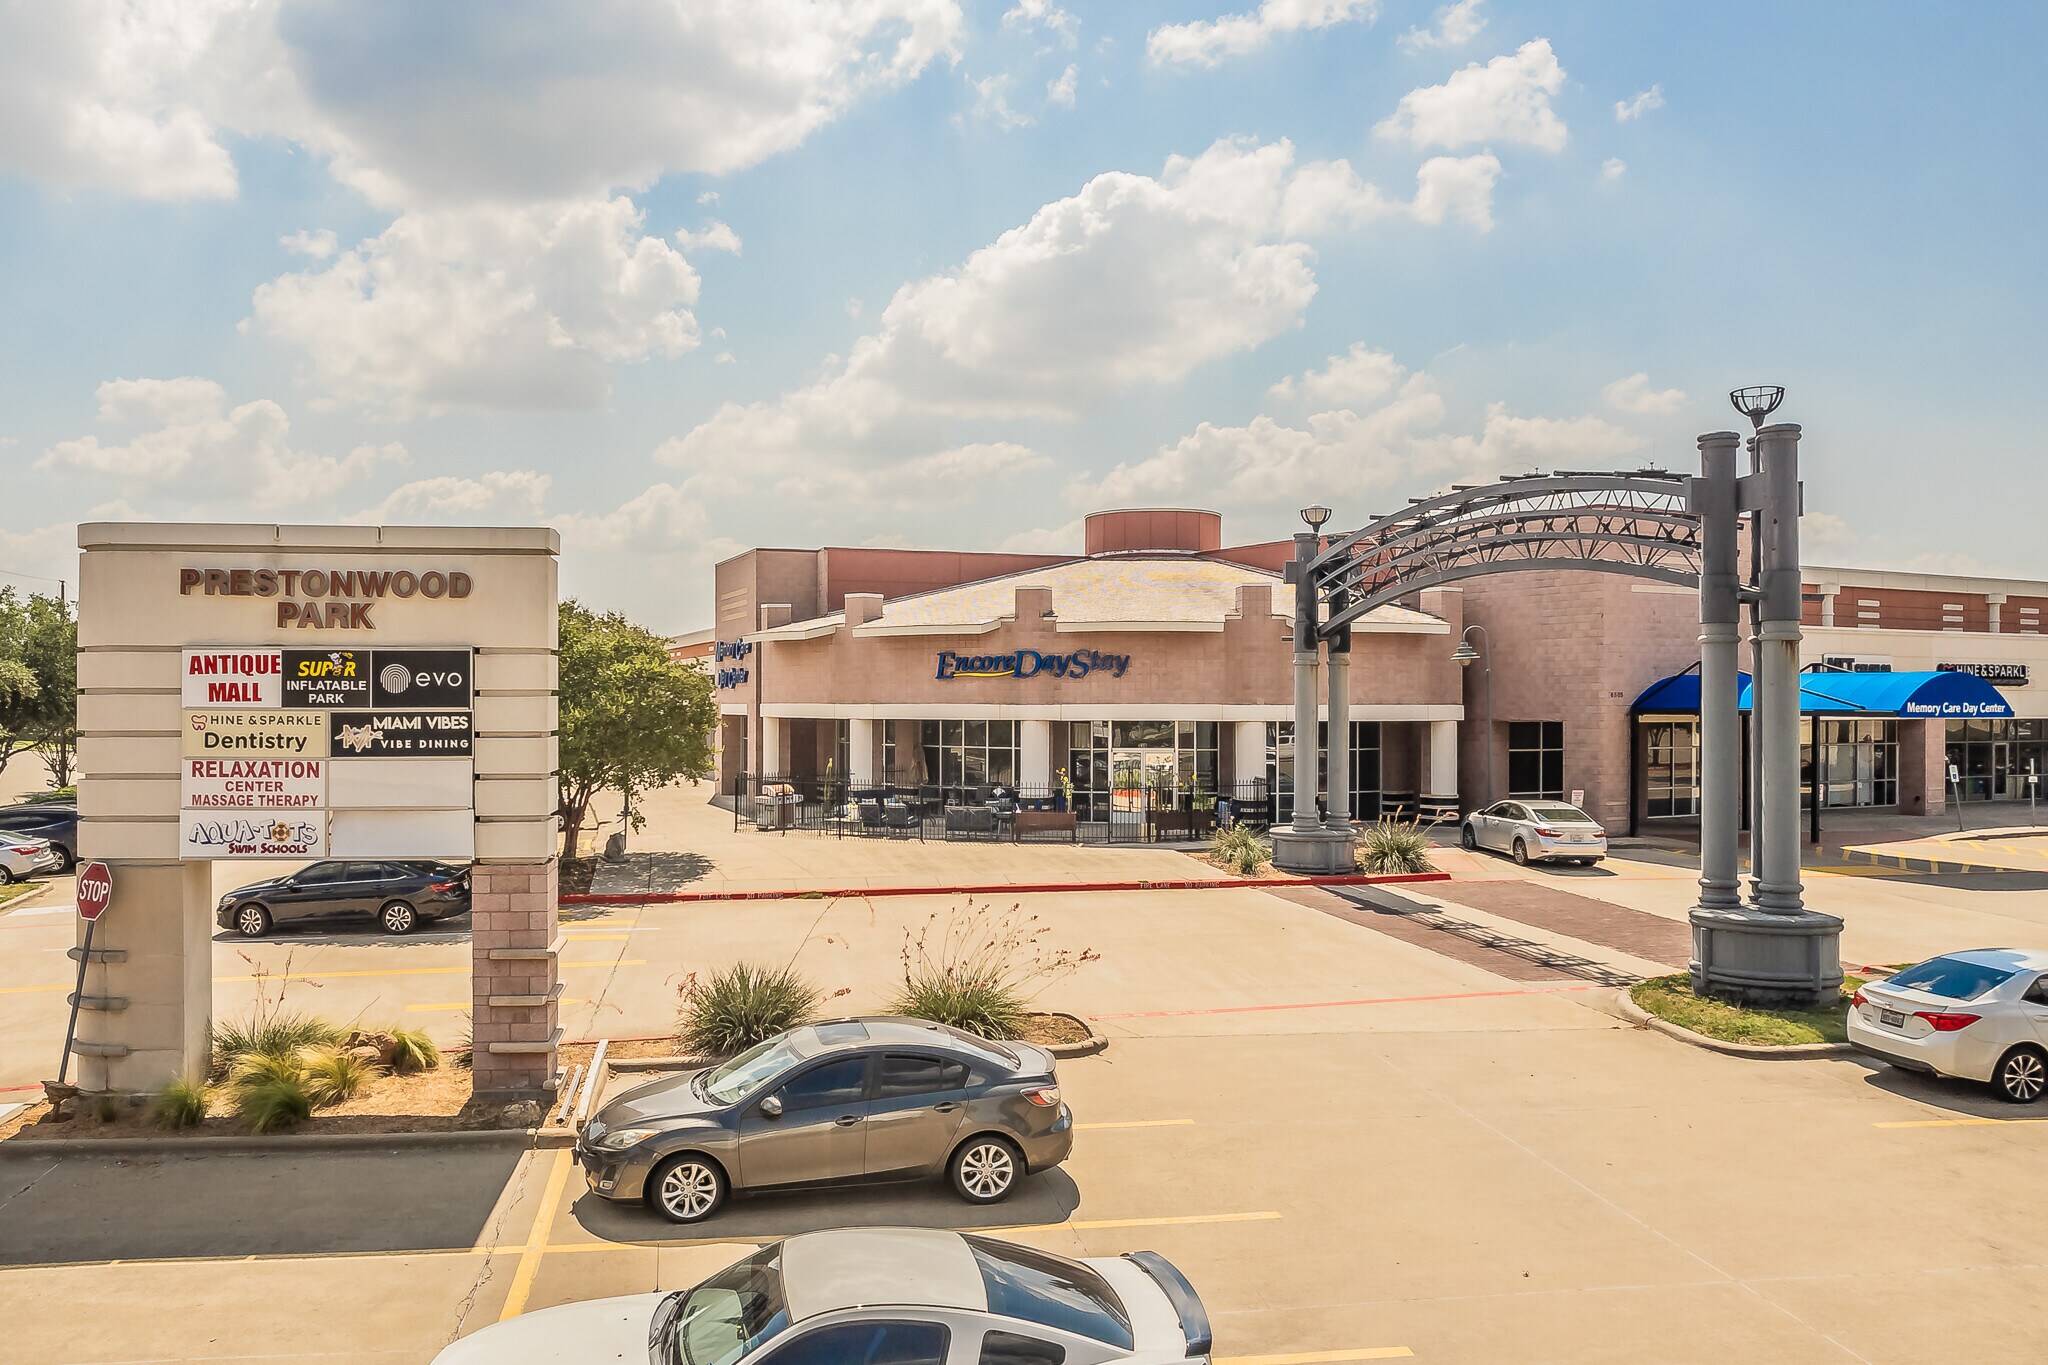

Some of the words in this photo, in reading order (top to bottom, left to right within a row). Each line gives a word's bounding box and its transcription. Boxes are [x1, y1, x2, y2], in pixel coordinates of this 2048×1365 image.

[180, 568, 474, 599] PRESTONWOOD
[277, 601, 376, 629] PARK
[188, 654, 282, 677] ANTIQUE
[286, 680, 367, 691] INFLATABLE
[415, 672, 463, 687] evo
[208, 682, 262, 703] MALL
[308, 693, 345, 704] PARK
[1906, 701, 1941, 717] Memory
[1942, 701, 1961, 713] Care
[1962, 702, 1979, 717] Day
[1979, 701, 2006, 713] Center
[373, 716, 422, 730] MIAMI
[425, 715, 469, 730] VIBES
[204, 731, 308, 753] Dentistry
[380, 739, 412, 749] VIBE
[419, 739, 469, 749] DINING
[191, 760, 320, 778] RELAXATION
[225, 781, 284, 792] CENTER
[191, 794, 254, 806] MASSAGE
[258, 795, 318, 807] THERAPY
[228, 842, 257, 855] SWIM
[260, 843, 308, 855] SCHOOLS
[79, 879, 109, 903] STOP
